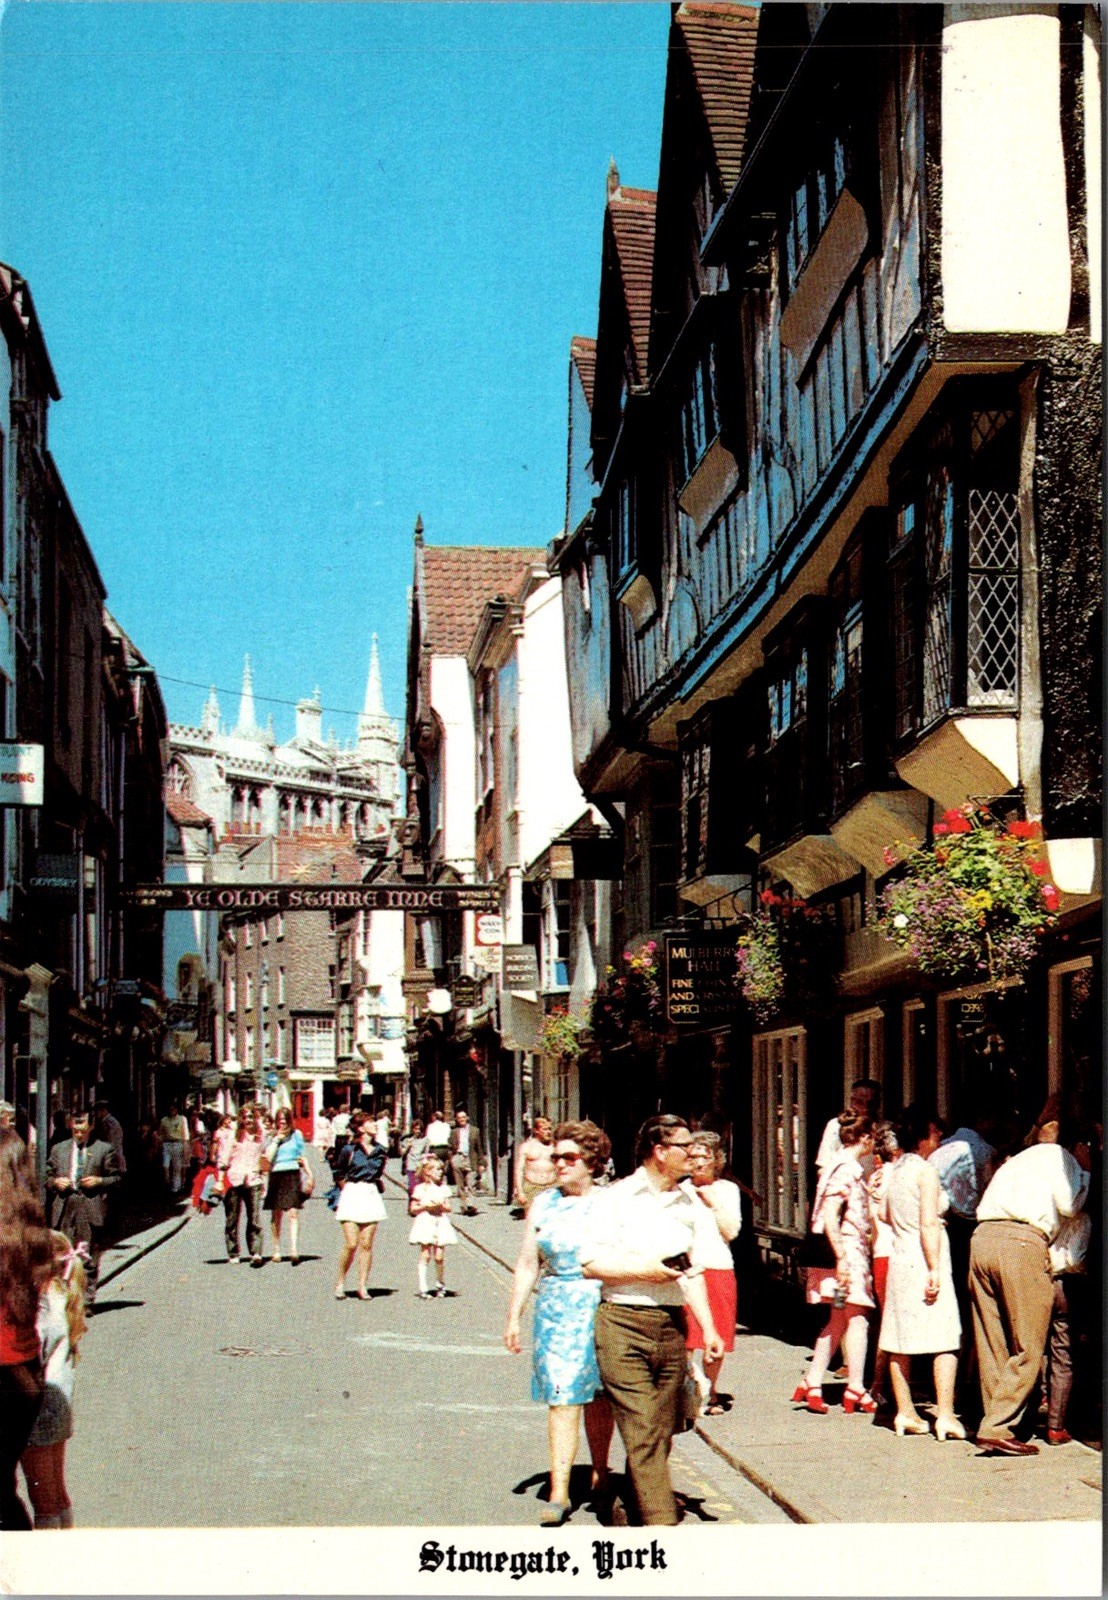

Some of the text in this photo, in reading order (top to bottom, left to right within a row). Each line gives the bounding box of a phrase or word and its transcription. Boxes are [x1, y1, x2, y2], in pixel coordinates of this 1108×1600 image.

[184, 889, 211, 907] YE
[217, 889, 280, 907] OLDE
[289, 890, 378, 907] STARRE
[672, 979, 694, 989] FINE
[670, 992, 695, 1001] AND
